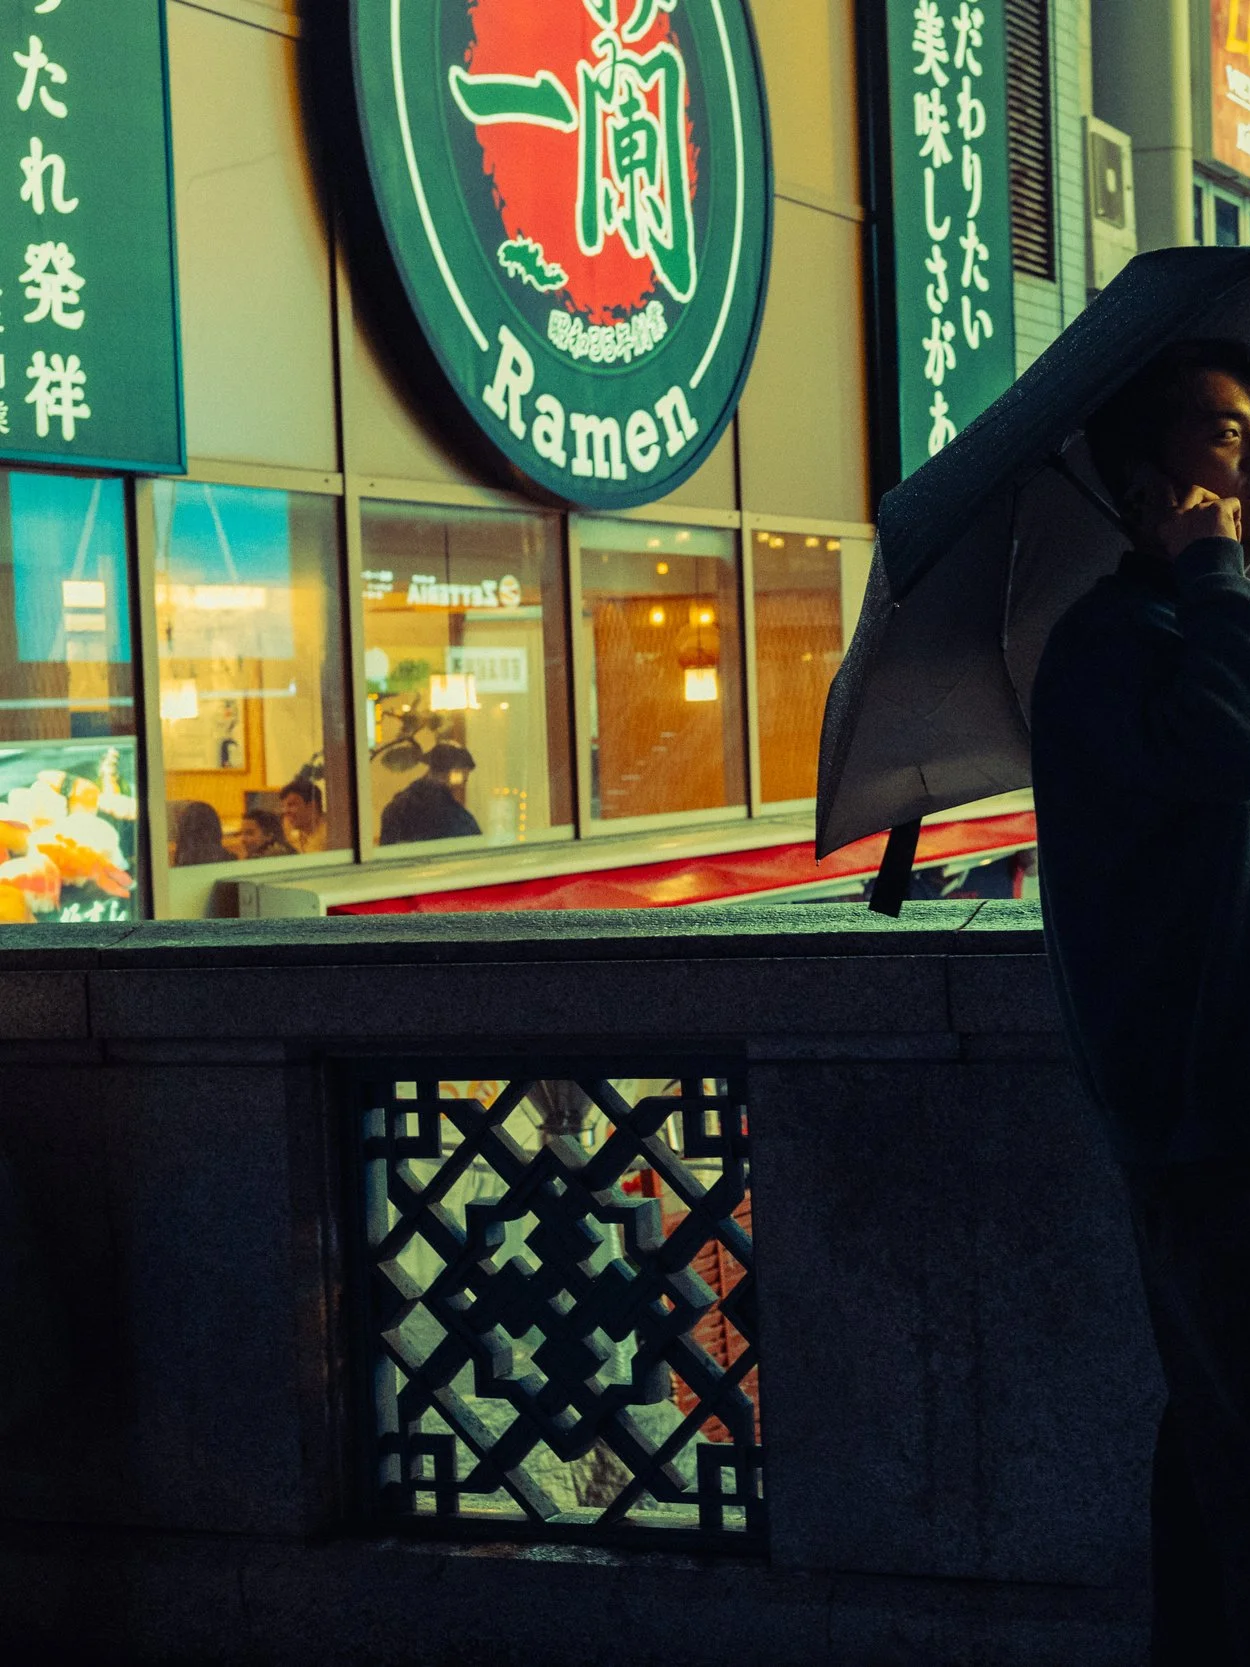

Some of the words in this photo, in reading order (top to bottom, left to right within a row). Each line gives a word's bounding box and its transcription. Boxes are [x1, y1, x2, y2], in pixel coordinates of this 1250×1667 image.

[951, 0, 993, 349] だわりたい
[482, 325, 698, 480] Ramen
